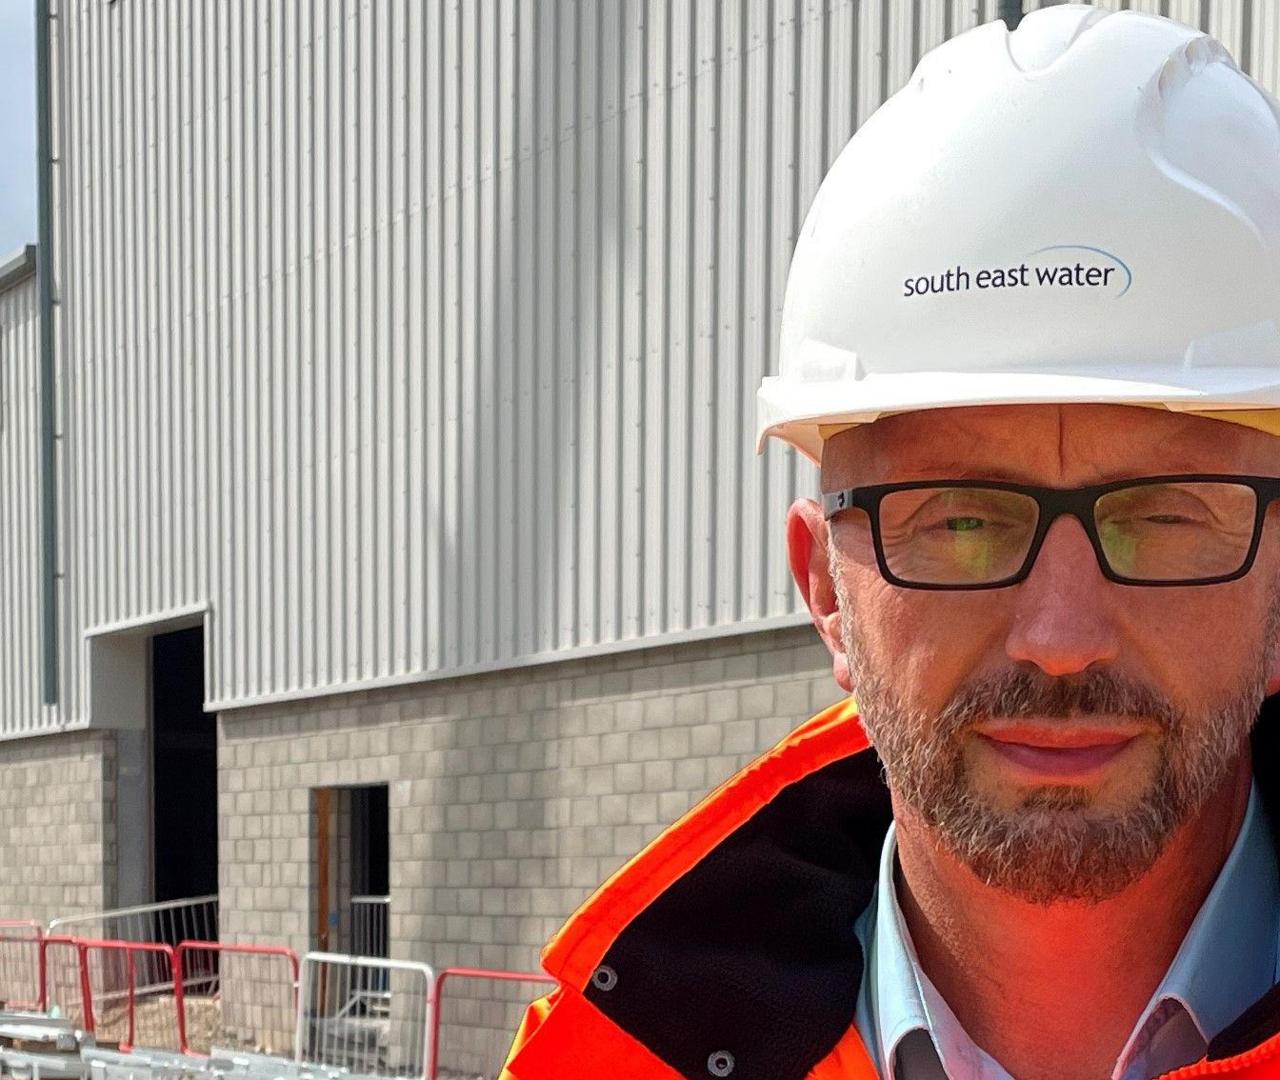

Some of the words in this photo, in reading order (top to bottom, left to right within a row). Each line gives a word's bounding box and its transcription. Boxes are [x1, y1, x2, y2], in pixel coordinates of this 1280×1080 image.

[903, 265, 970, 297] south
[976, 263, 1029, 289] east
[1035, 262, 1115, 287] water
